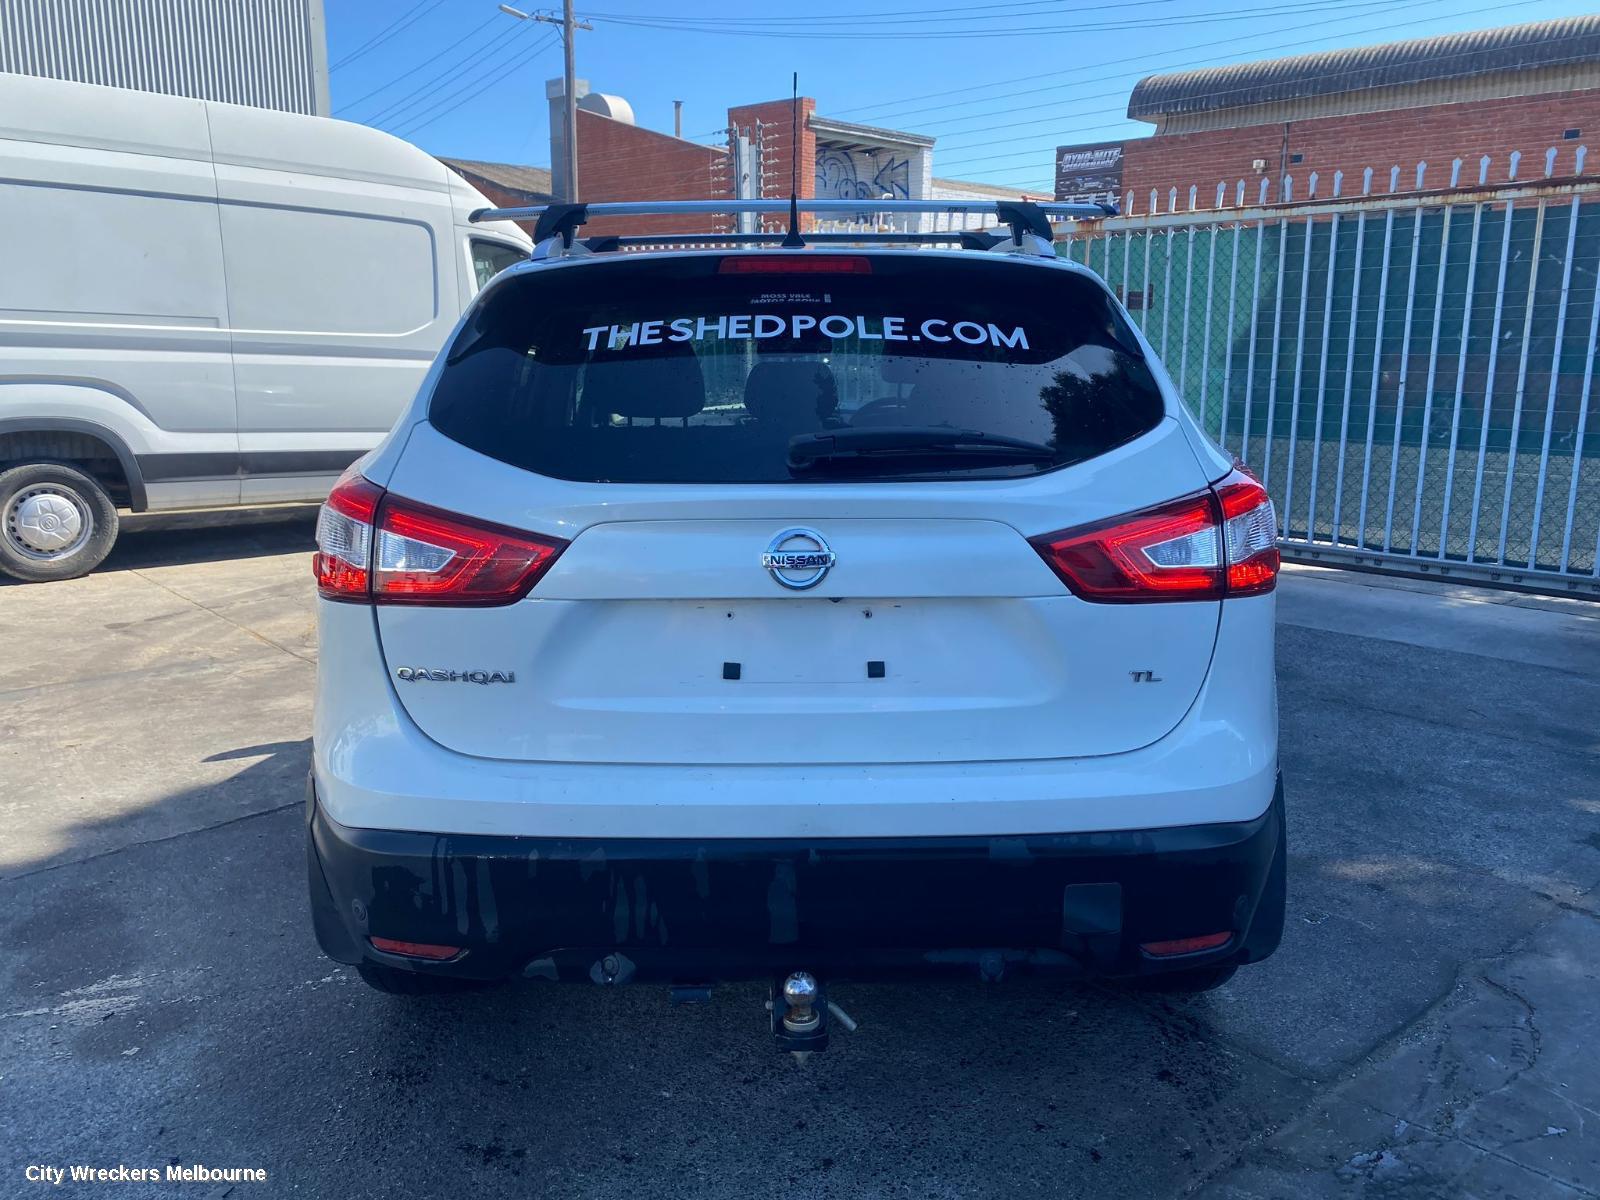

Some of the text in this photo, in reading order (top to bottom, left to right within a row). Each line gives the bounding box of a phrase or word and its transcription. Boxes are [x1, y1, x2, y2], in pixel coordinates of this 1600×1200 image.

[583, 314, 1030, 351] THESHEDPOLE.COM
[770, 554, 829, 566] NISSAN
[397, 667, 516, 685] QASHQAI
[1128, 670, 1162, 682] TL
